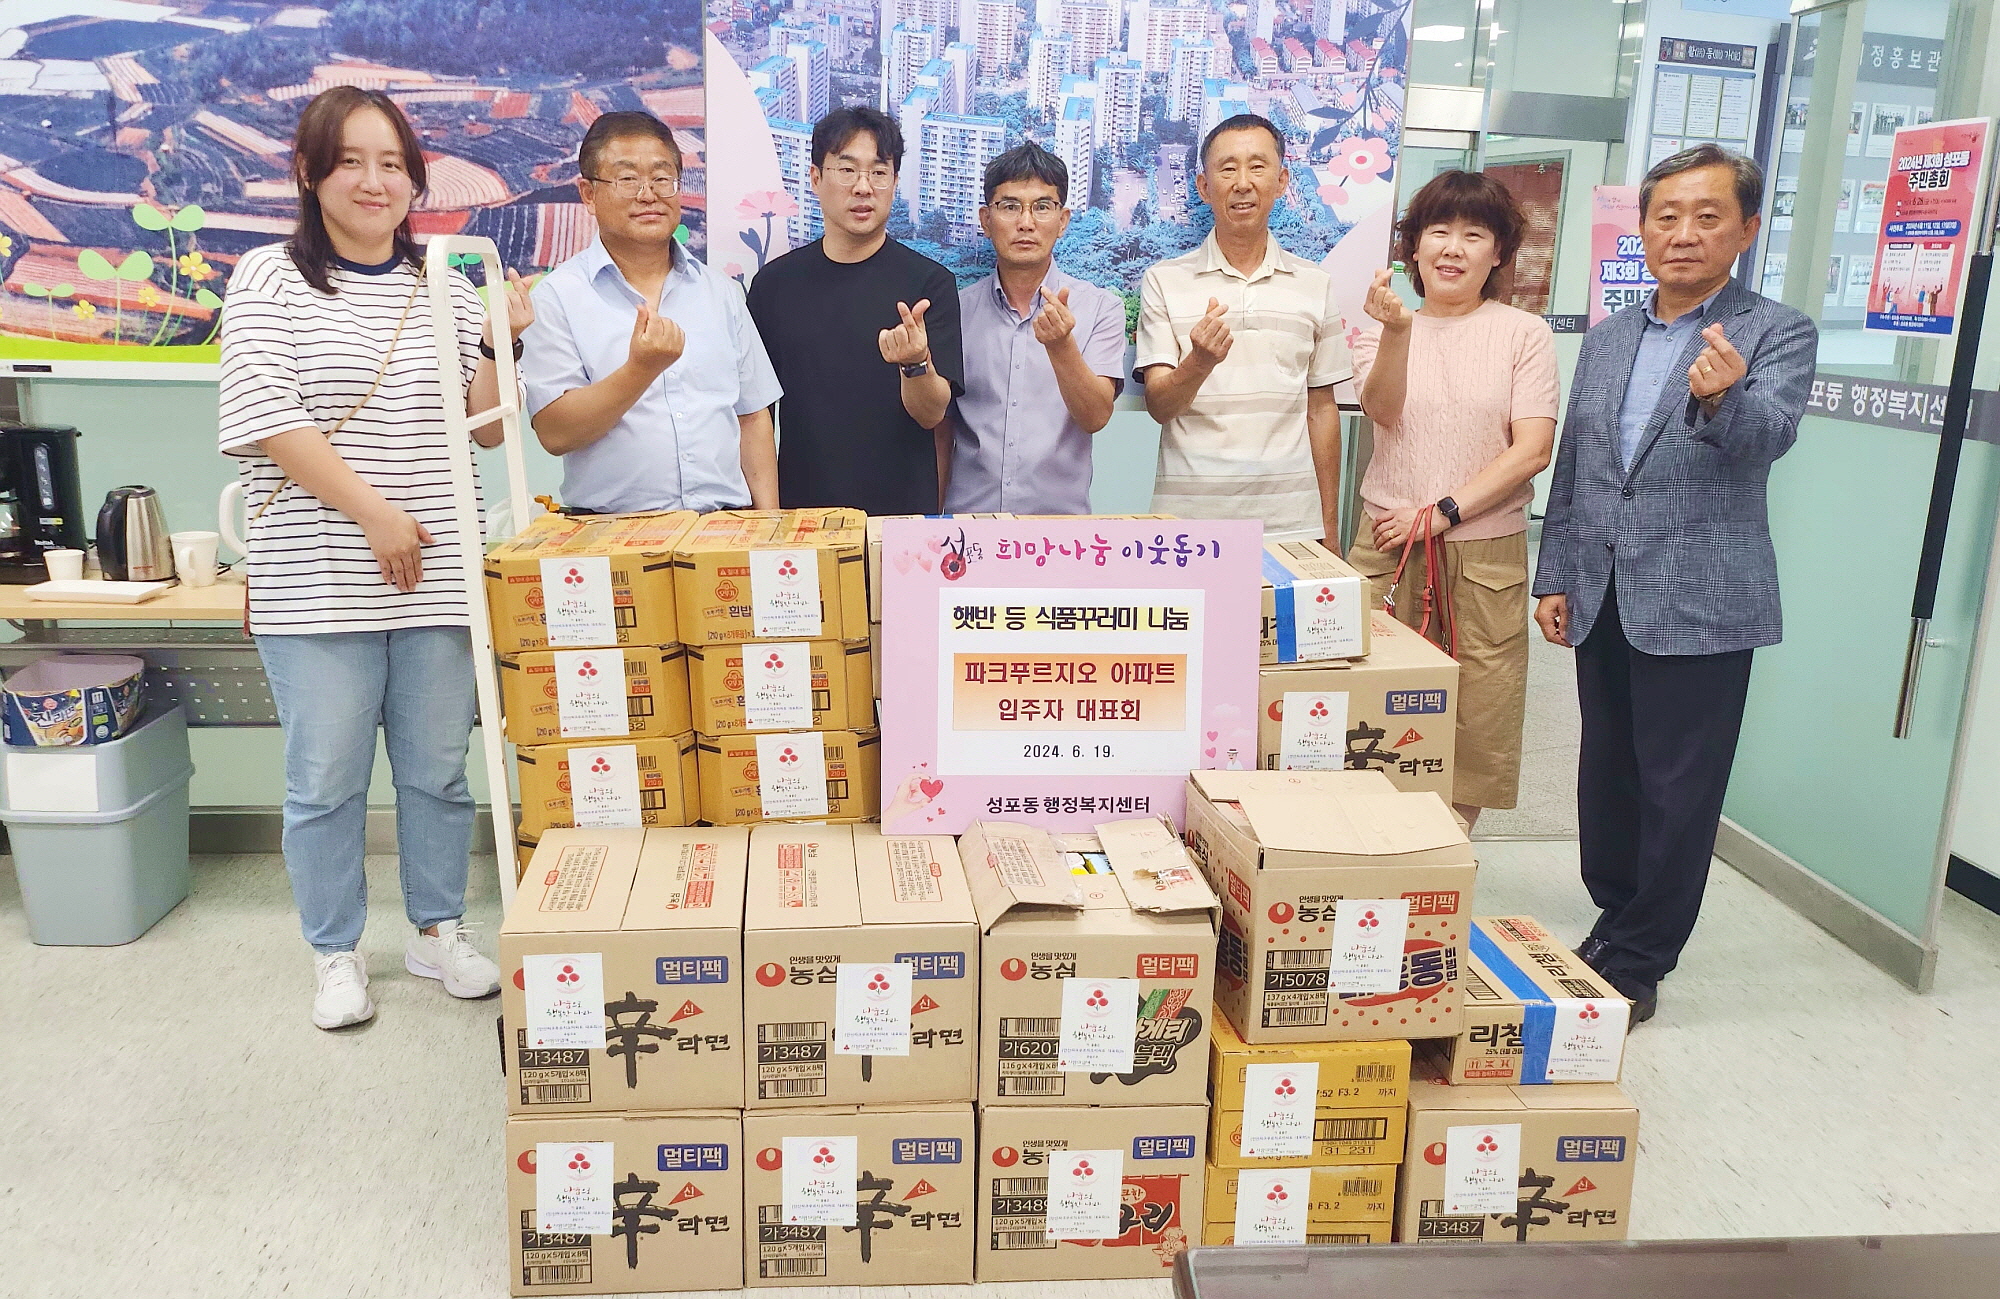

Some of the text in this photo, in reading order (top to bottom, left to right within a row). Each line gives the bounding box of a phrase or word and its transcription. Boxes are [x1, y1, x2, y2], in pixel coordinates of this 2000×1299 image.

[1898, 155, 1923, 171] 2024년
[1924, 153, 1943, 169] 제3회
[1909, 169, 1951, 191] 주민총회
[1618, 236, 1645, 256] 202
[1601, 261, 1639, 282] 제3회
[1603, 288, 1654, 314] 주민
[995, 532, 1112, 567] 희망나눔
[1121, 533, 1222, 568] 이웃돕기
[729, 605, 752, 617] 흰밥
[953, 606, 1189, 631] 햇반 등 식품꾸러미 나눔
[965, 661, 1176, 684] 파크푸르지오 아파트
[998, 698, 1141, 722] 입주자 대표회
[1391, 692, 1441, 712] 멀티팩
[1406, 731, 1415, 741] 신
[1023, 744, 1115, 758] 2024. 6. 19.
[1399, 758, 1444, 776] 라면
[986, 795, 1150, 814] 성포동 행정복지센터
[790, 955, 841, 964] 인생을 맛있게
[1031, 952, 1076, 960] 인생을 맛있게
[662, 960, 722, 981] 멀티팩
[1030, 962, 1076, 979] 농심
[1141, 956, 1194, 976] 멀티팩
[1270, 973, 1326, 987] 가5078
[683, 1004, 695, 1015] 신
[919, 999, 930, 1010] 신
[677, 1034, 730, 1054] 라면
[912, 1028, 963, 1049] 라면
[524, 1050, 584, 1065] 가3487
[763, 1045, 822, 1061] 가3487
[1005, 1041, 1059, 1056] 가6201
[1378, 1088, 1396, 1097] 까지
[899, 1141, 956, 1161] 멀티팩
[1023, 1140, 1044, 1148] 인생을
[1139, 1139, 1189, 1156] 멀티팩
[1563, 1139, 1620, 1160] 멀티팩
[664, 1147, 722, 1169] 멀티팩
[684, 1187, 695, 1197] 신
[917, 1182, 928, 1194] 신
[1577, 1180, 1588, 1191] 신
[1367, 1202, 1385, 1211] 까지
[677, 1215, 730, 1235] 라면
[910, 1211, 961, 1230] 라면
[1567, 1209, 1617, 1227] 라면
[764, 1226, 821, 1241] 가3487
[1423, 1221, 1480, 1235] 가3487
